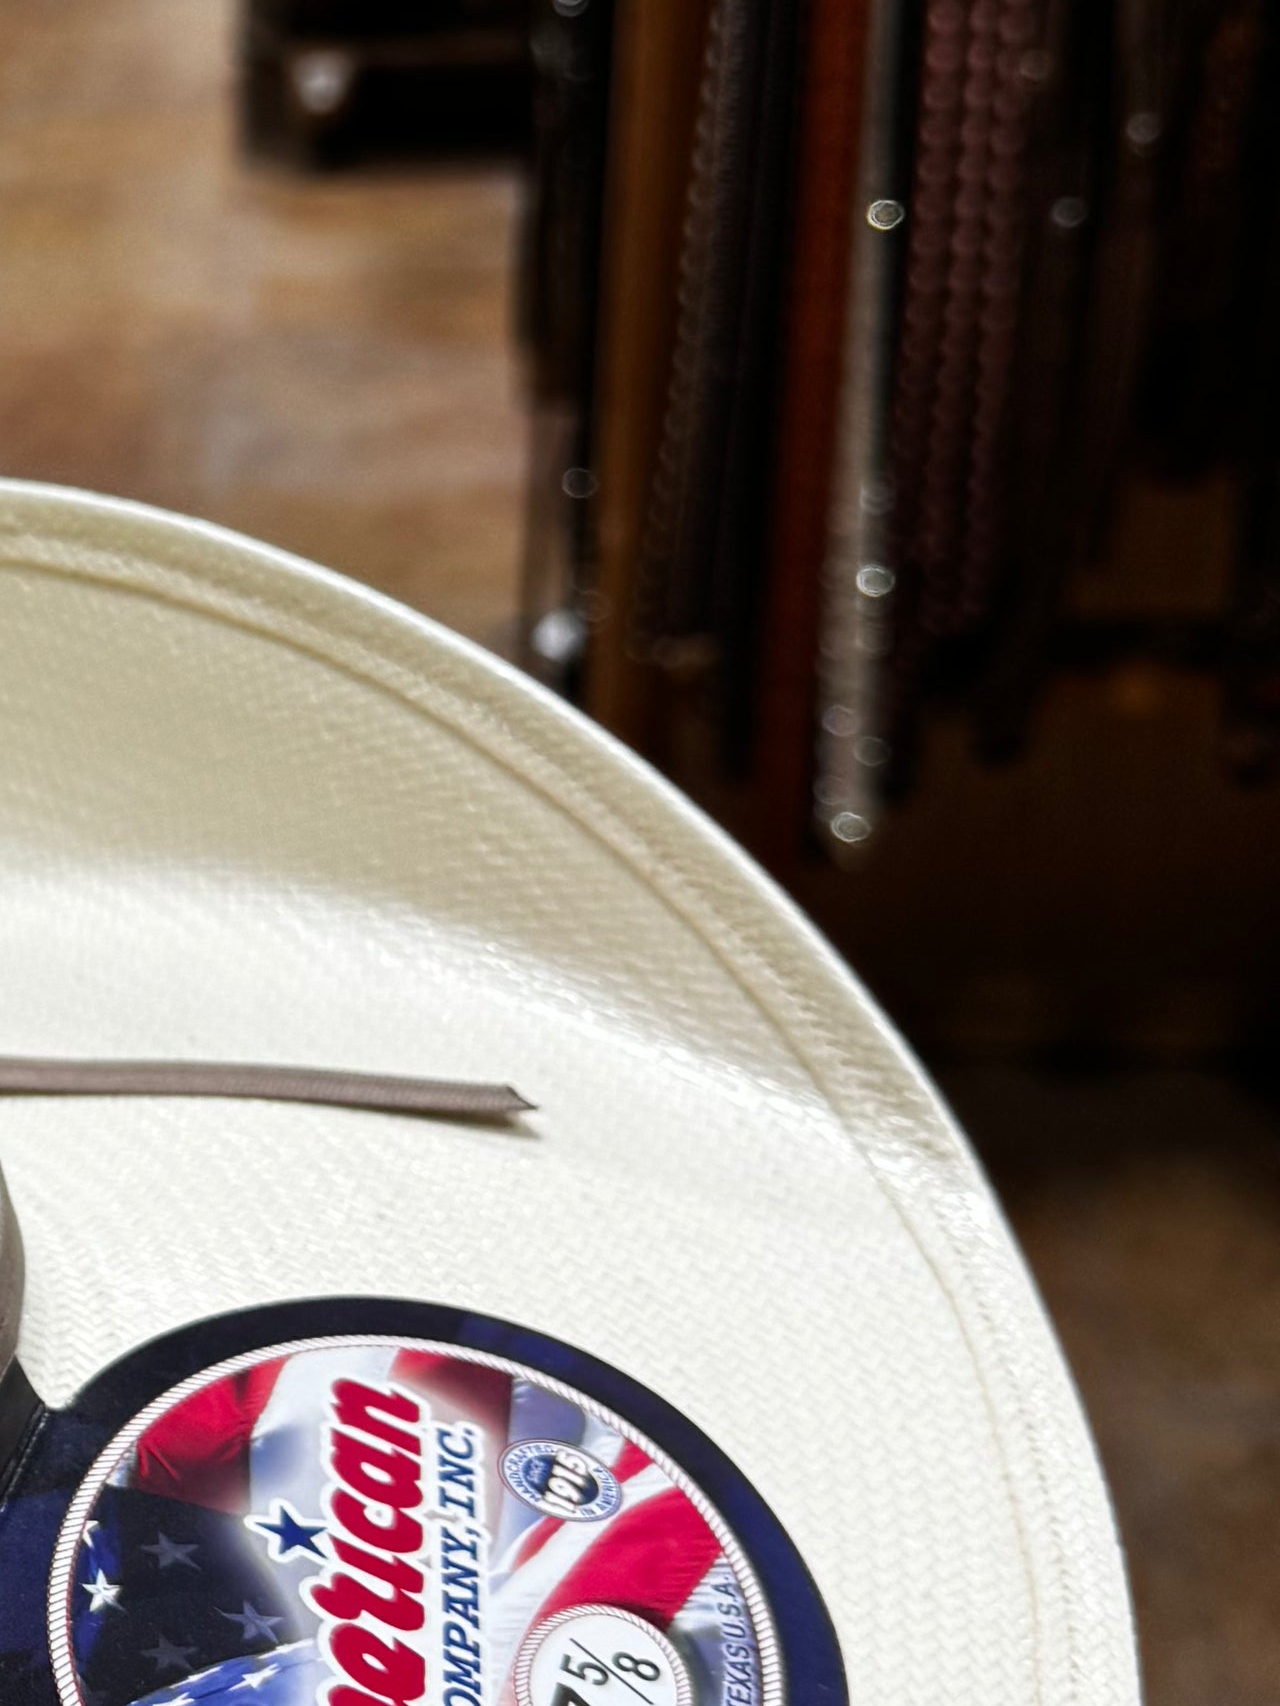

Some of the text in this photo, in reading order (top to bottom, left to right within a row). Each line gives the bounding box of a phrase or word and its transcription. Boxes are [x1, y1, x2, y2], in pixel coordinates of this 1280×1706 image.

[436, 1427, 476, 1519] INC.
[541, 1449, 589, 1514] 1915
[711, 1576, 747, 1639] U.S.A.
